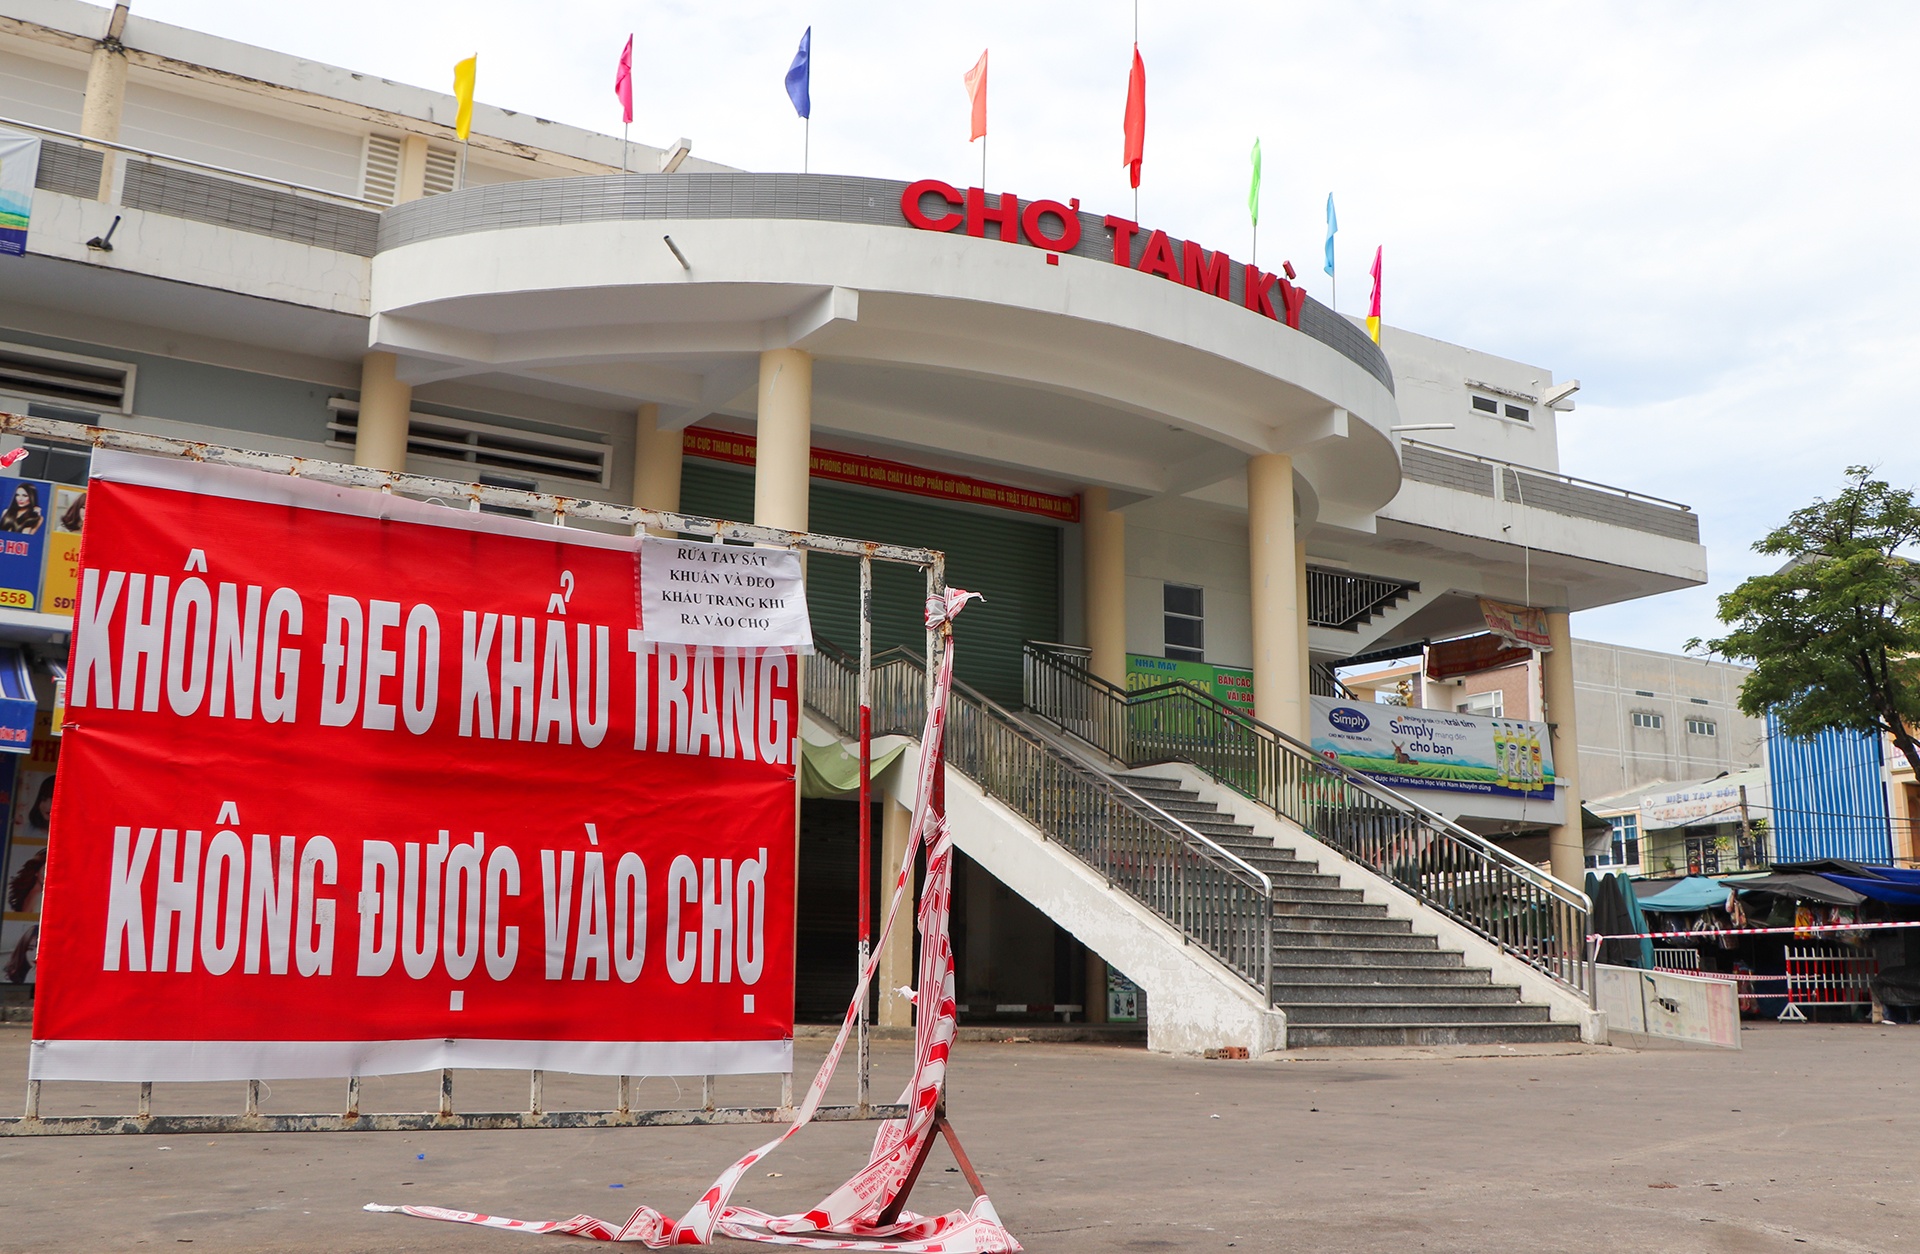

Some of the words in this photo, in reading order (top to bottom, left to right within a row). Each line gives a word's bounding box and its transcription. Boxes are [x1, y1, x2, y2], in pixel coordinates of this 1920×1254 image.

[901, 179, 1081, 266] CHỢ
[1104, 214, 1229, 300] TAM
[1245, 260, 1307, 329] KỲ
[712, 440, 731, 454] THAM
[732, 444, 744, 457] GIA
[711, 551, 739, 564] TAY
[741, 552, 768, 567] SÁT
[724, 573, 742, 586] VÀ
[746, 576, 775, 589] ĐEO
[706, 594, 755, 608] TRANG
[759, 598, 785, 609] KHI
[681, 613, 700, 625] RA
[704, 613, 734, 627] VÀO
[738, 617, 770, 630] CHỢ
[71, 549, 303, 723] KHÔNG
[320, 595, 440, 735] ĐEO
[458, 570, 609, 748] KHẨU
[1158, 661, 1177, 671] MAY
[1332, 709, 1366, 729] Simply
[1460, 719, 1476, 728] tim
[1389, 716, 1434, 740] Simply
[1409, 741, 1430, 752] cho
[1433, 742, 1453, 758] bạn
[103, 801, 336, 976] KHÔNG
[357, 829, 520, 1011] ĐƯỢC
[541, 823, 645, 983] VÀO
[666, 848, 766, 1013] CHỢ
